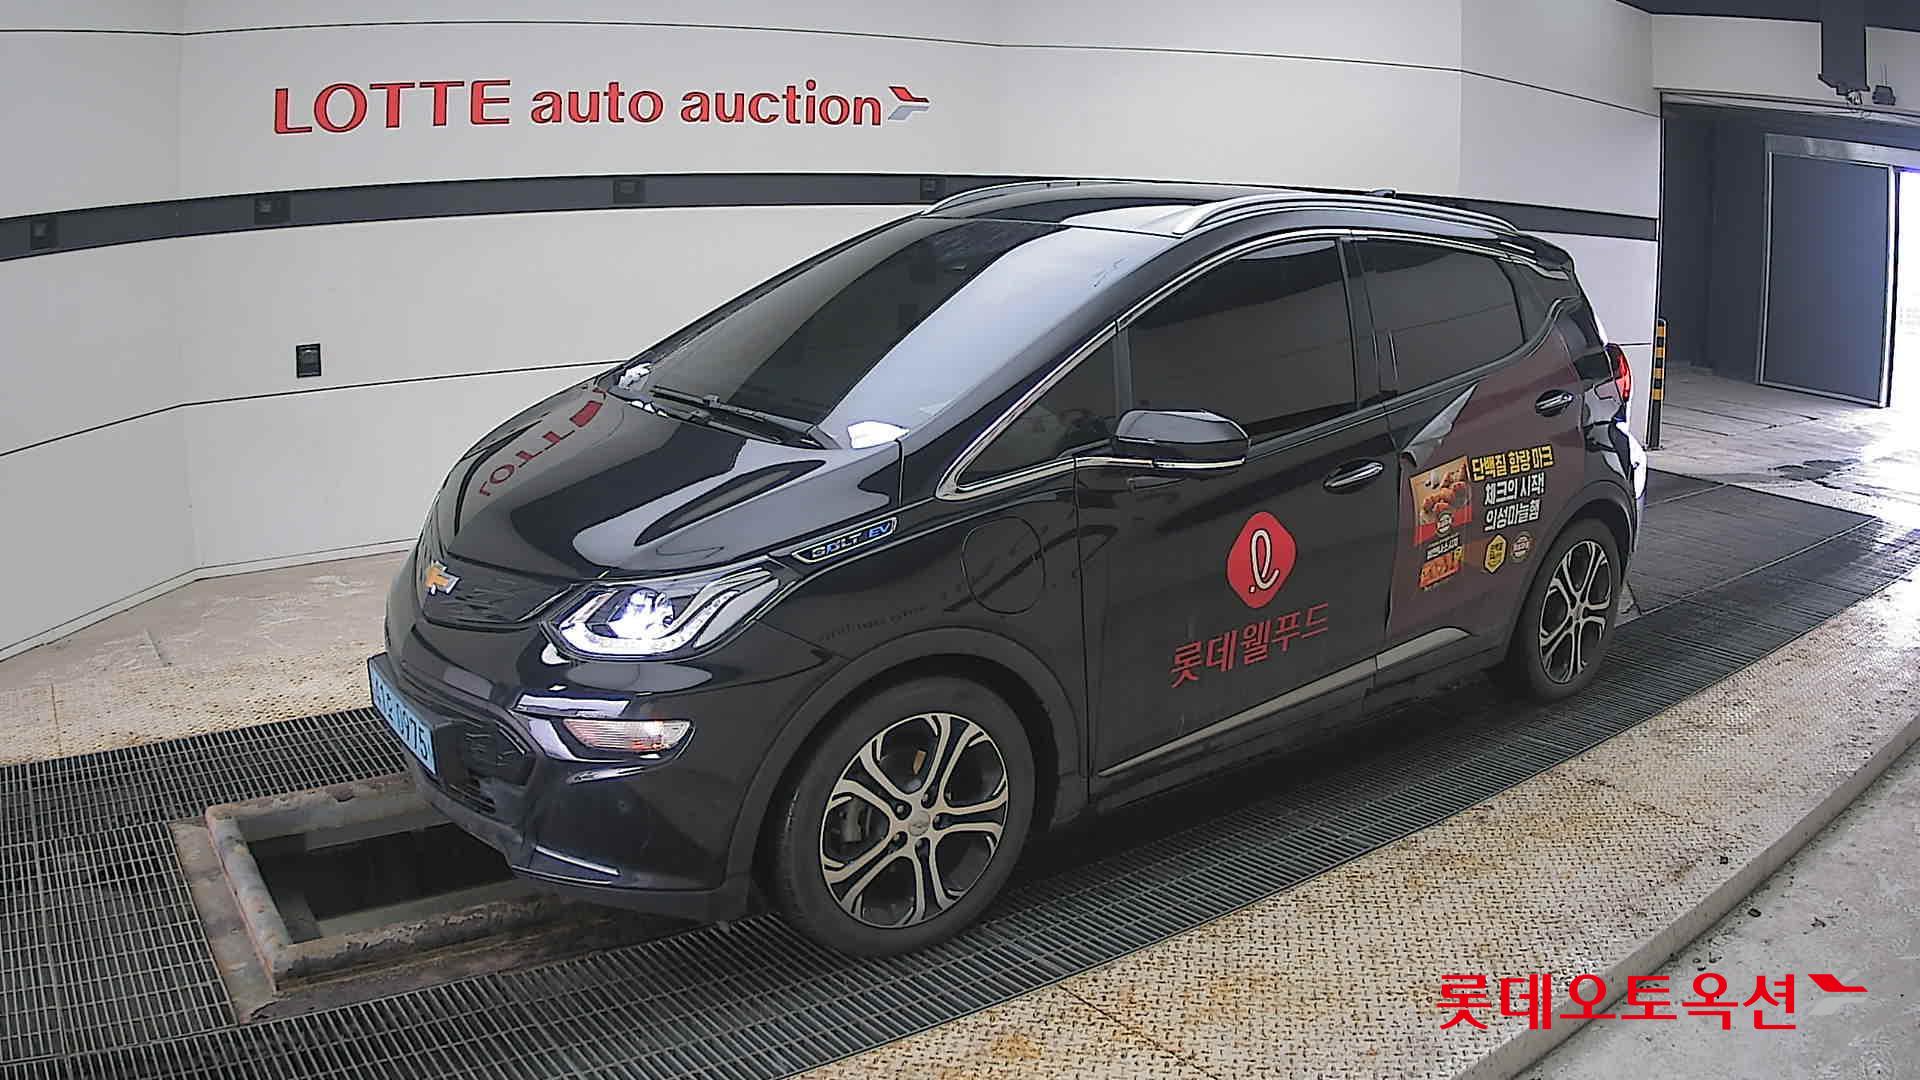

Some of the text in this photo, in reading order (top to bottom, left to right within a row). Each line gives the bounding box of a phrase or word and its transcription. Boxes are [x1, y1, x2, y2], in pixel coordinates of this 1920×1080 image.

[274, 79, 881, 134] LOTTE auto auction
[1471, 453, 1507, 481] 단백질
[1508, 449, 1531, 474] 함량
[1520, 472, 1545, 497] 시작!
[868, 522, 891, 538] EV
[1168, 602, 1329, 688] 롯데웰푸드
